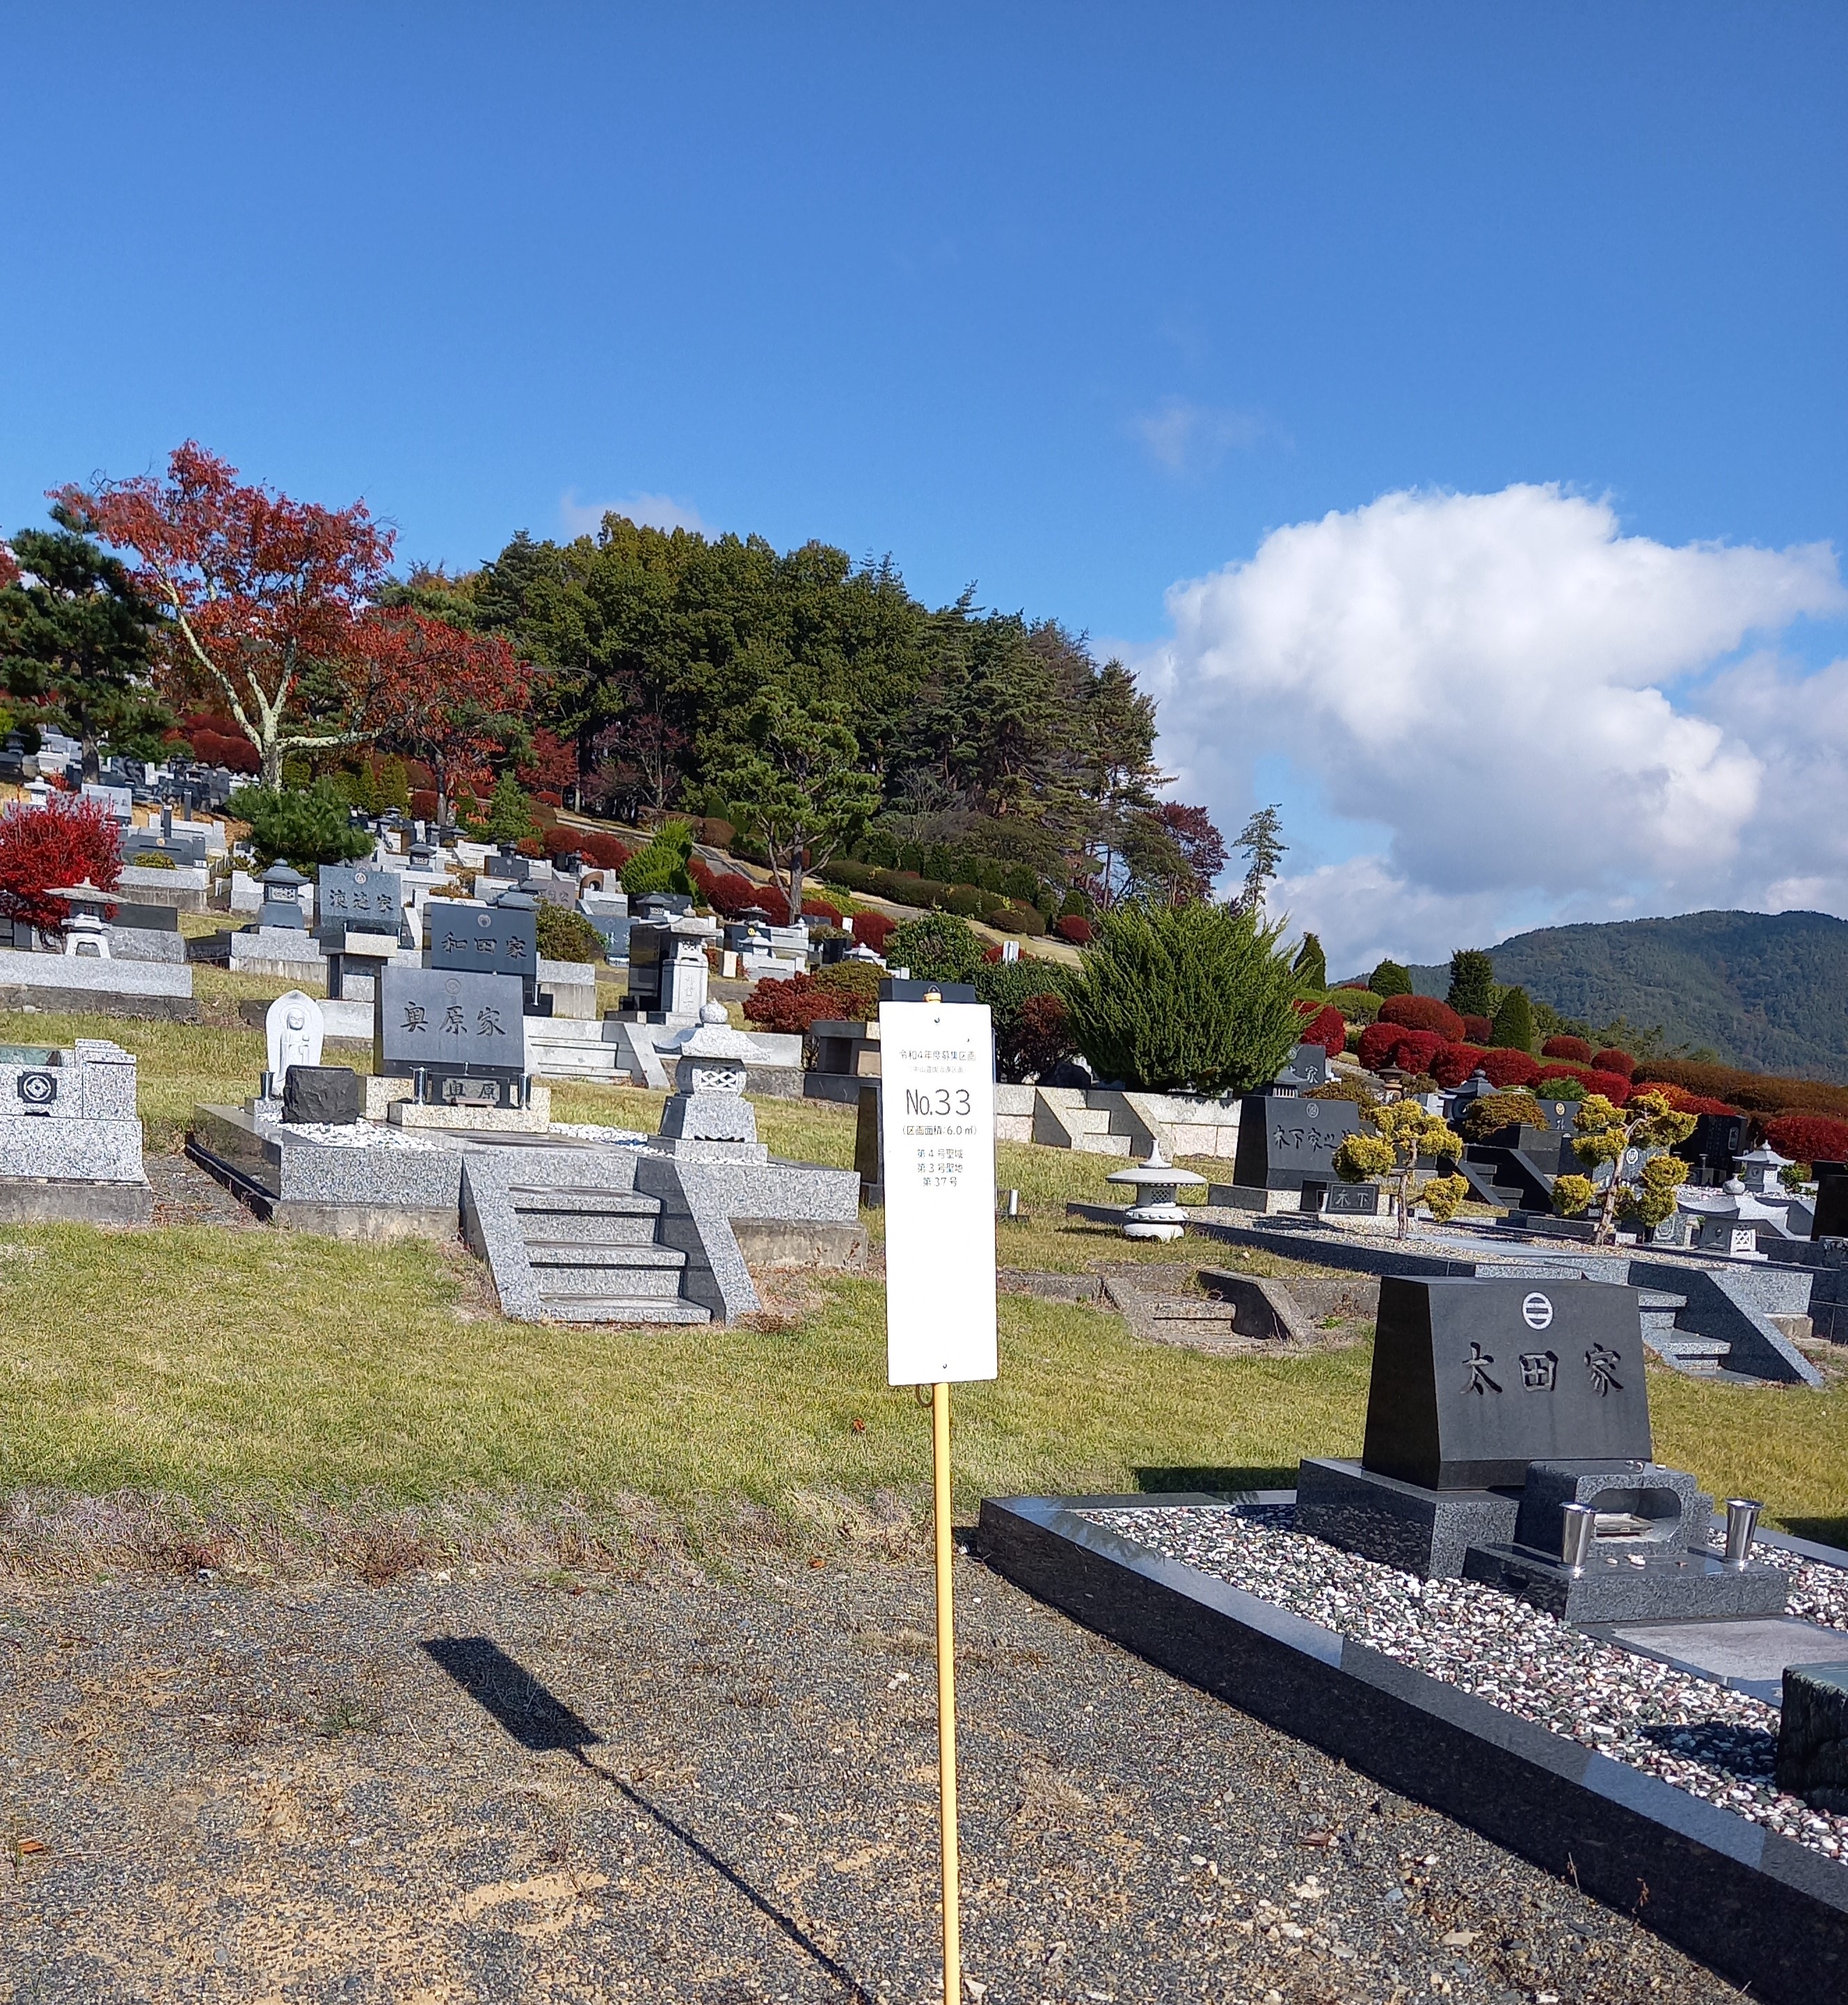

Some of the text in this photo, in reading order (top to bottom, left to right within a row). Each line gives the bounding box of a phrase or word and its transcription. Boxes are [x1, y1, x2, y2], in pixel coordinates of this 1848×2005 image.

[441, 931, 527, 960] 和田家
[399, 1000, 507, 1037] 奥原家
[906, 1089, 971, 1116] No.33
[1273, 1124, 1353, 1153] 木下家之
[1335, 1188, 1369, 1208] 木下
[1458, 1341, 1625, 1398] 太田家
